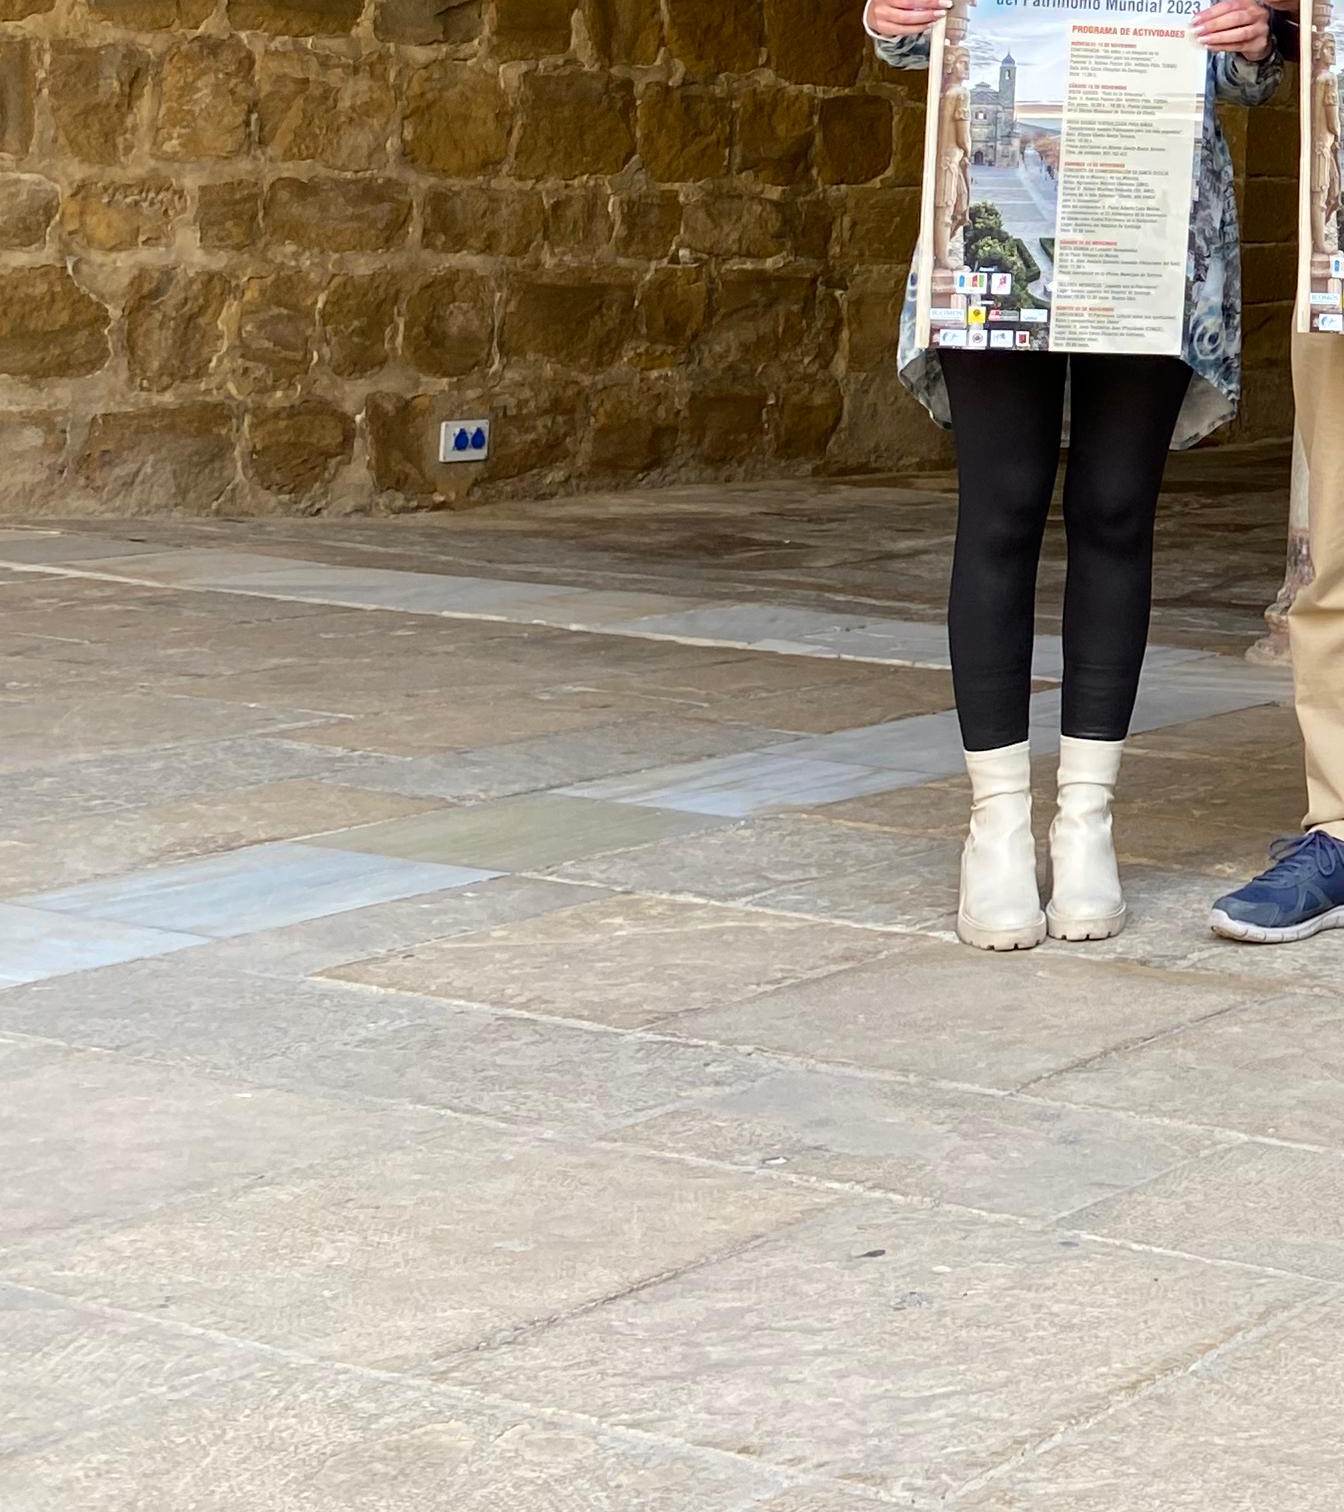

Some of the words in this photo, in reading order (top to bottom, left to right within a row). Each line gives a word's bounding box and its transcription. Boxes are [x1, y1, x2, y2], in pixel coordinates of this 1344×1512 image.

[1167, 0, 1201, 15] 2023
[1072, 25, 1118, 36] PROGRAMA
[1120, 27, 1131, 36] DE
[1132, 27, 1186, 38] ACTIVIDADES
